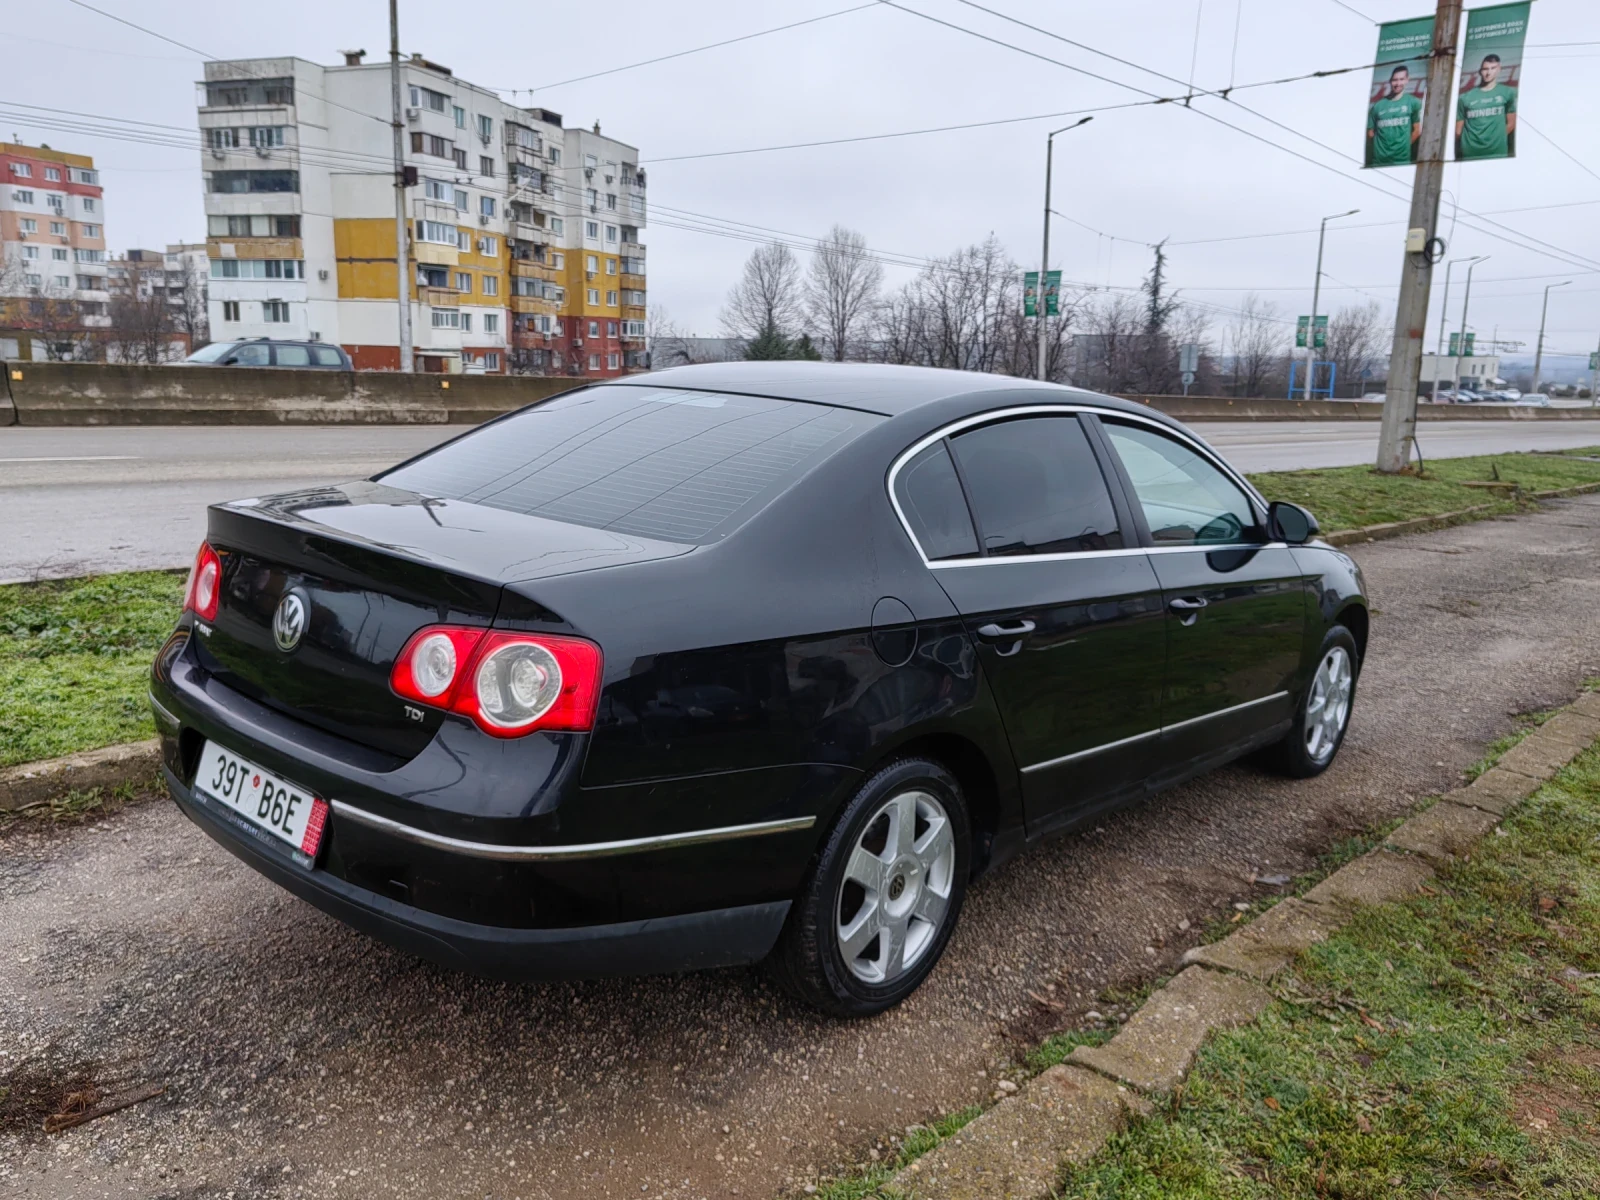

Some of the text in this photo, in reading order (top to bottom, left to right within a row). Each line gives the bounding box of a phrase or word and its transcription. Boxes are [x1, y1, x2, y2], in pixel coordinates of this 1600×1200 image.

[1467, 106, 1504, 118] WINBET
[404, 705, 425, 722] TDI
[212, 754, 250, 804] 39T
[257, 779, 302, 835] B6E
